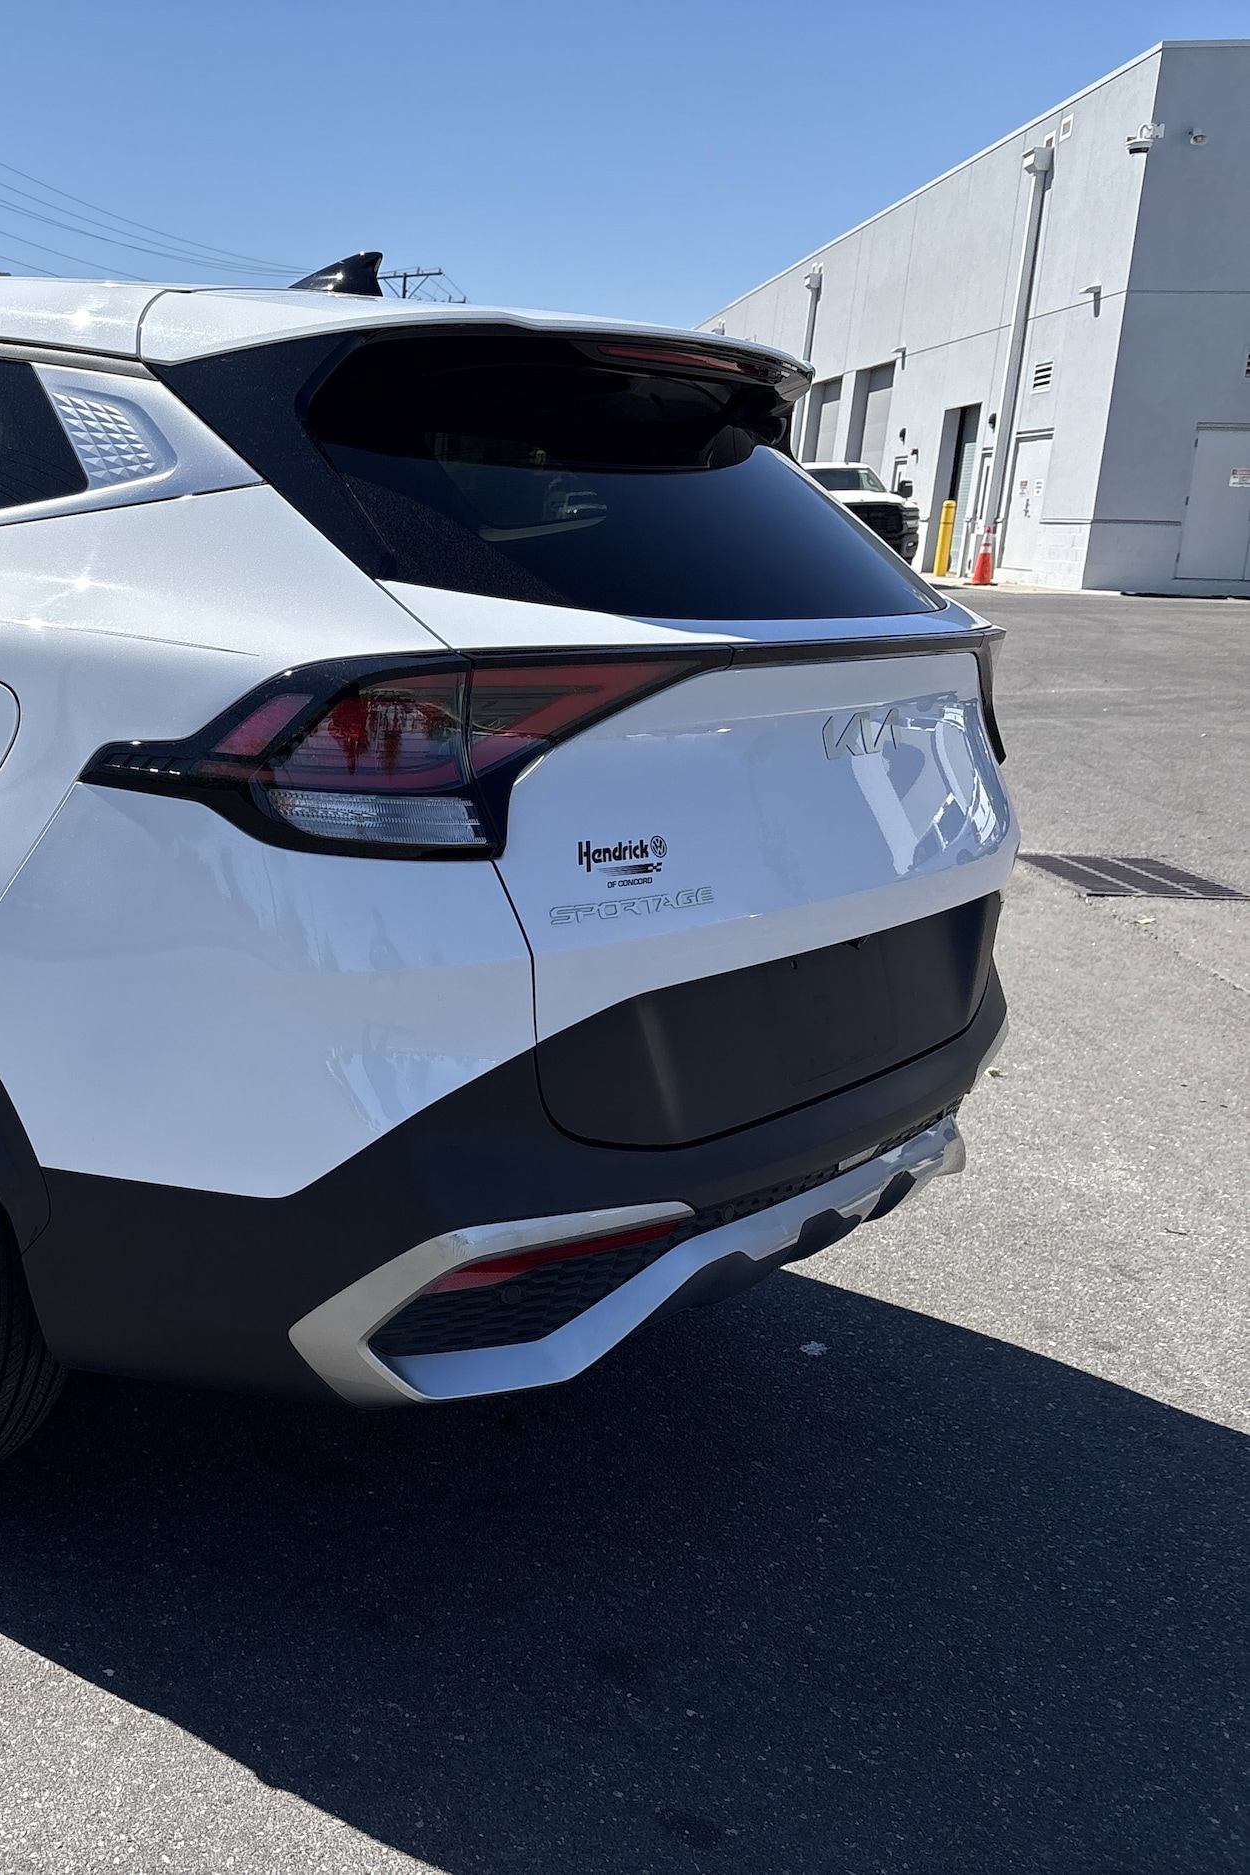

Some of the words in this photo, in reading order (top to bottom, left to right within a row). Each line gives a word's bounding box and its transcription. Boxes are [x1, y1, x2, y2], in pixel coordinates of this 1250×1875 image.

[822, 708, 902, 760] KIA
[577, 840, 649, 873] Hendrick
[607, 880, 617, 888] OF
[618, 877, 653, 888] CONCORD
[548, 885, 715, 925] SPORTAGE
